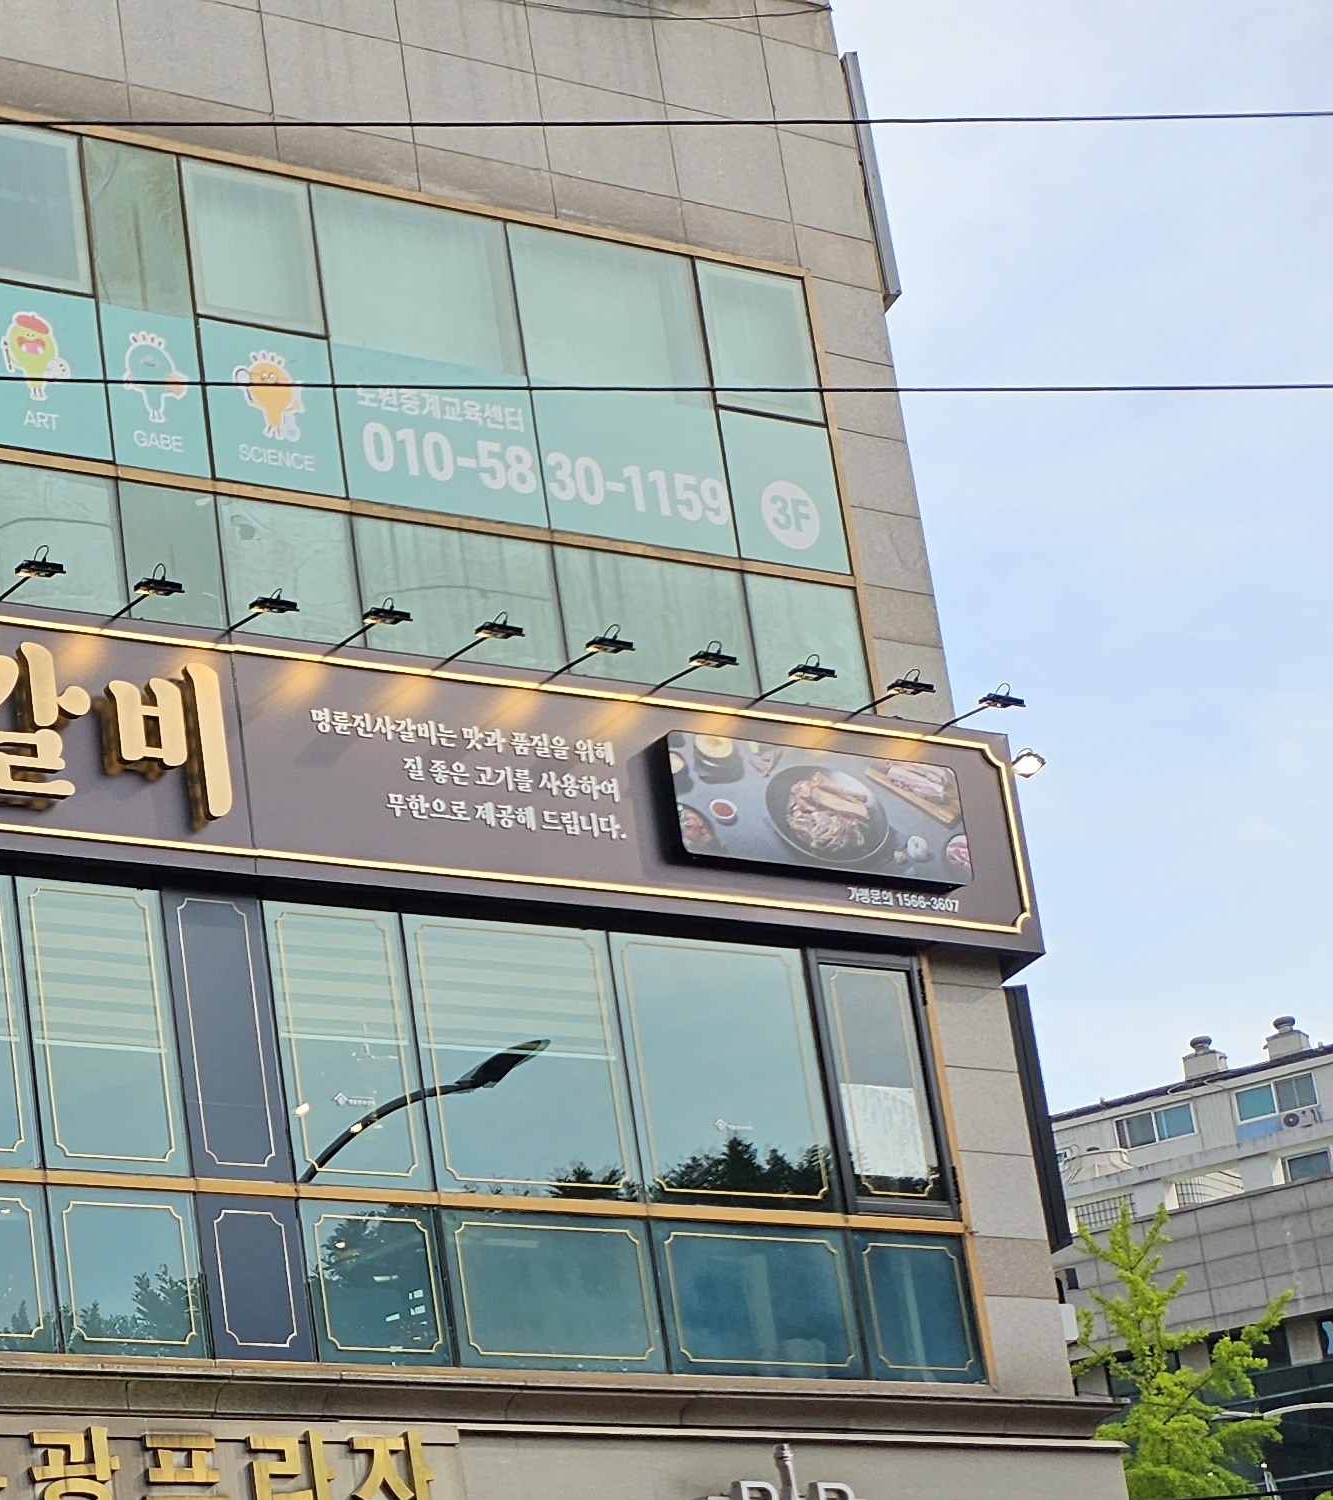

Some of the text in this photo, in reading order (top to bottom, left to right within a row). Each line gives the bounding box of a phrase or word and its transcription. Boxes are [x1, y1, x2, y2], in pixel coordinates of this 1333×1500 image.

[23, 409, 60, 432] ART
[133, 429, 185, 454] GABE
[238, 443, 316, 473] SCIENCE
[770, 488, 814, 533] 3F
[309, 707, 617, 767] 명륜진사갈비는 맛과 품질을 위해
[402, 756, 622, 804] 질 좋은 고기를 사용하여
[386, 795, 629, 841] 무한으로 제공해 드립니다.
[896, 892, 961, 913] 1566-3607
